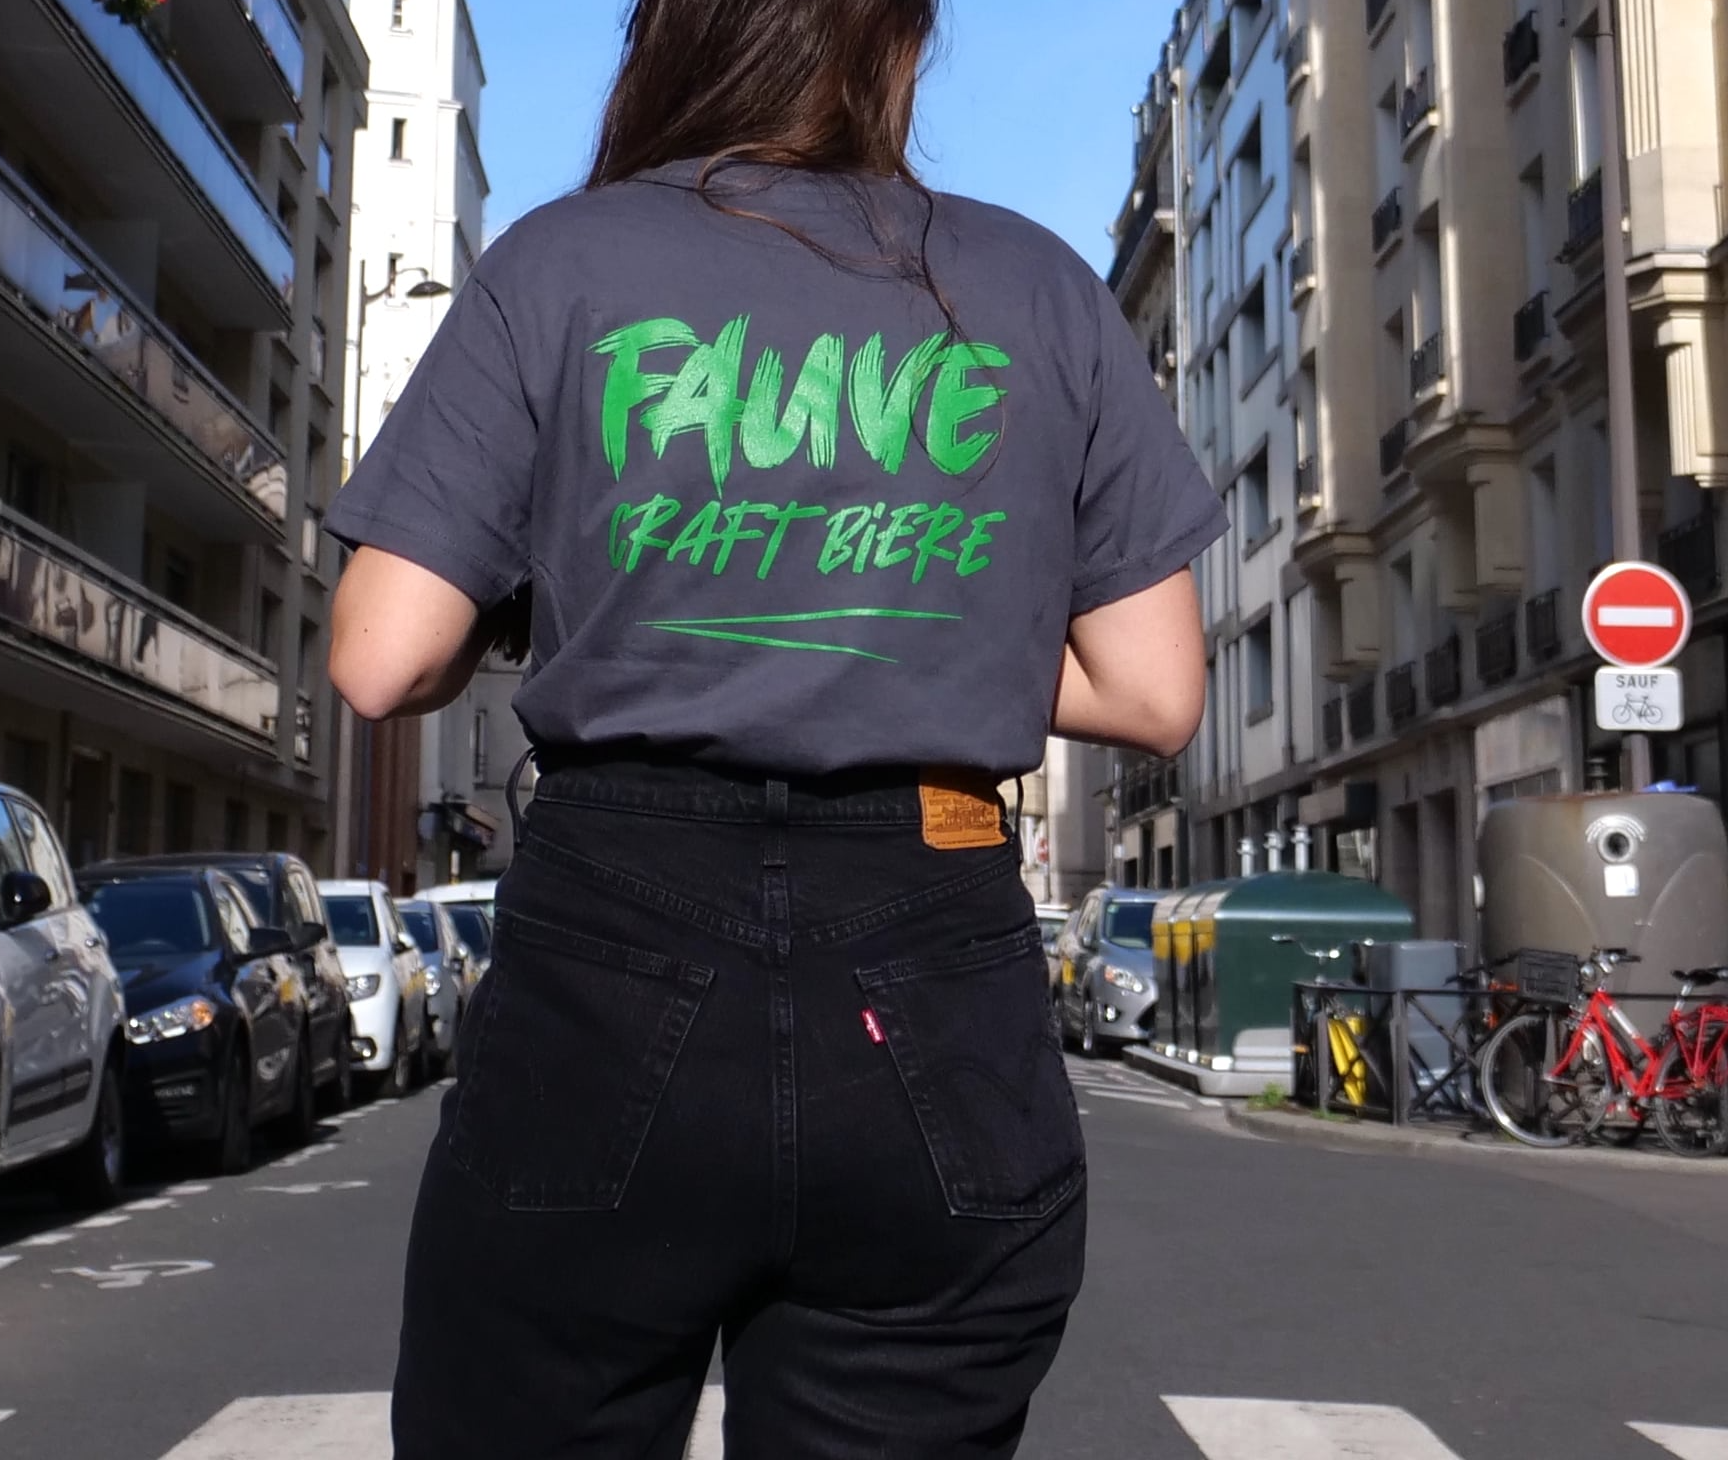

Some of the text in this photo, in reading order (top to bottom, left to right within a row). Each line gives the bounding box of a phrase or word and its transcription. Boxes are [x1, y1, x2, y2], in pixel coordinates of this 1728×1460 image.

[589, 314, 1010, 497] FAUVE
[609, 493, 826, 579] CRAFT
[1615, 674, 1659, 689] SAUF
